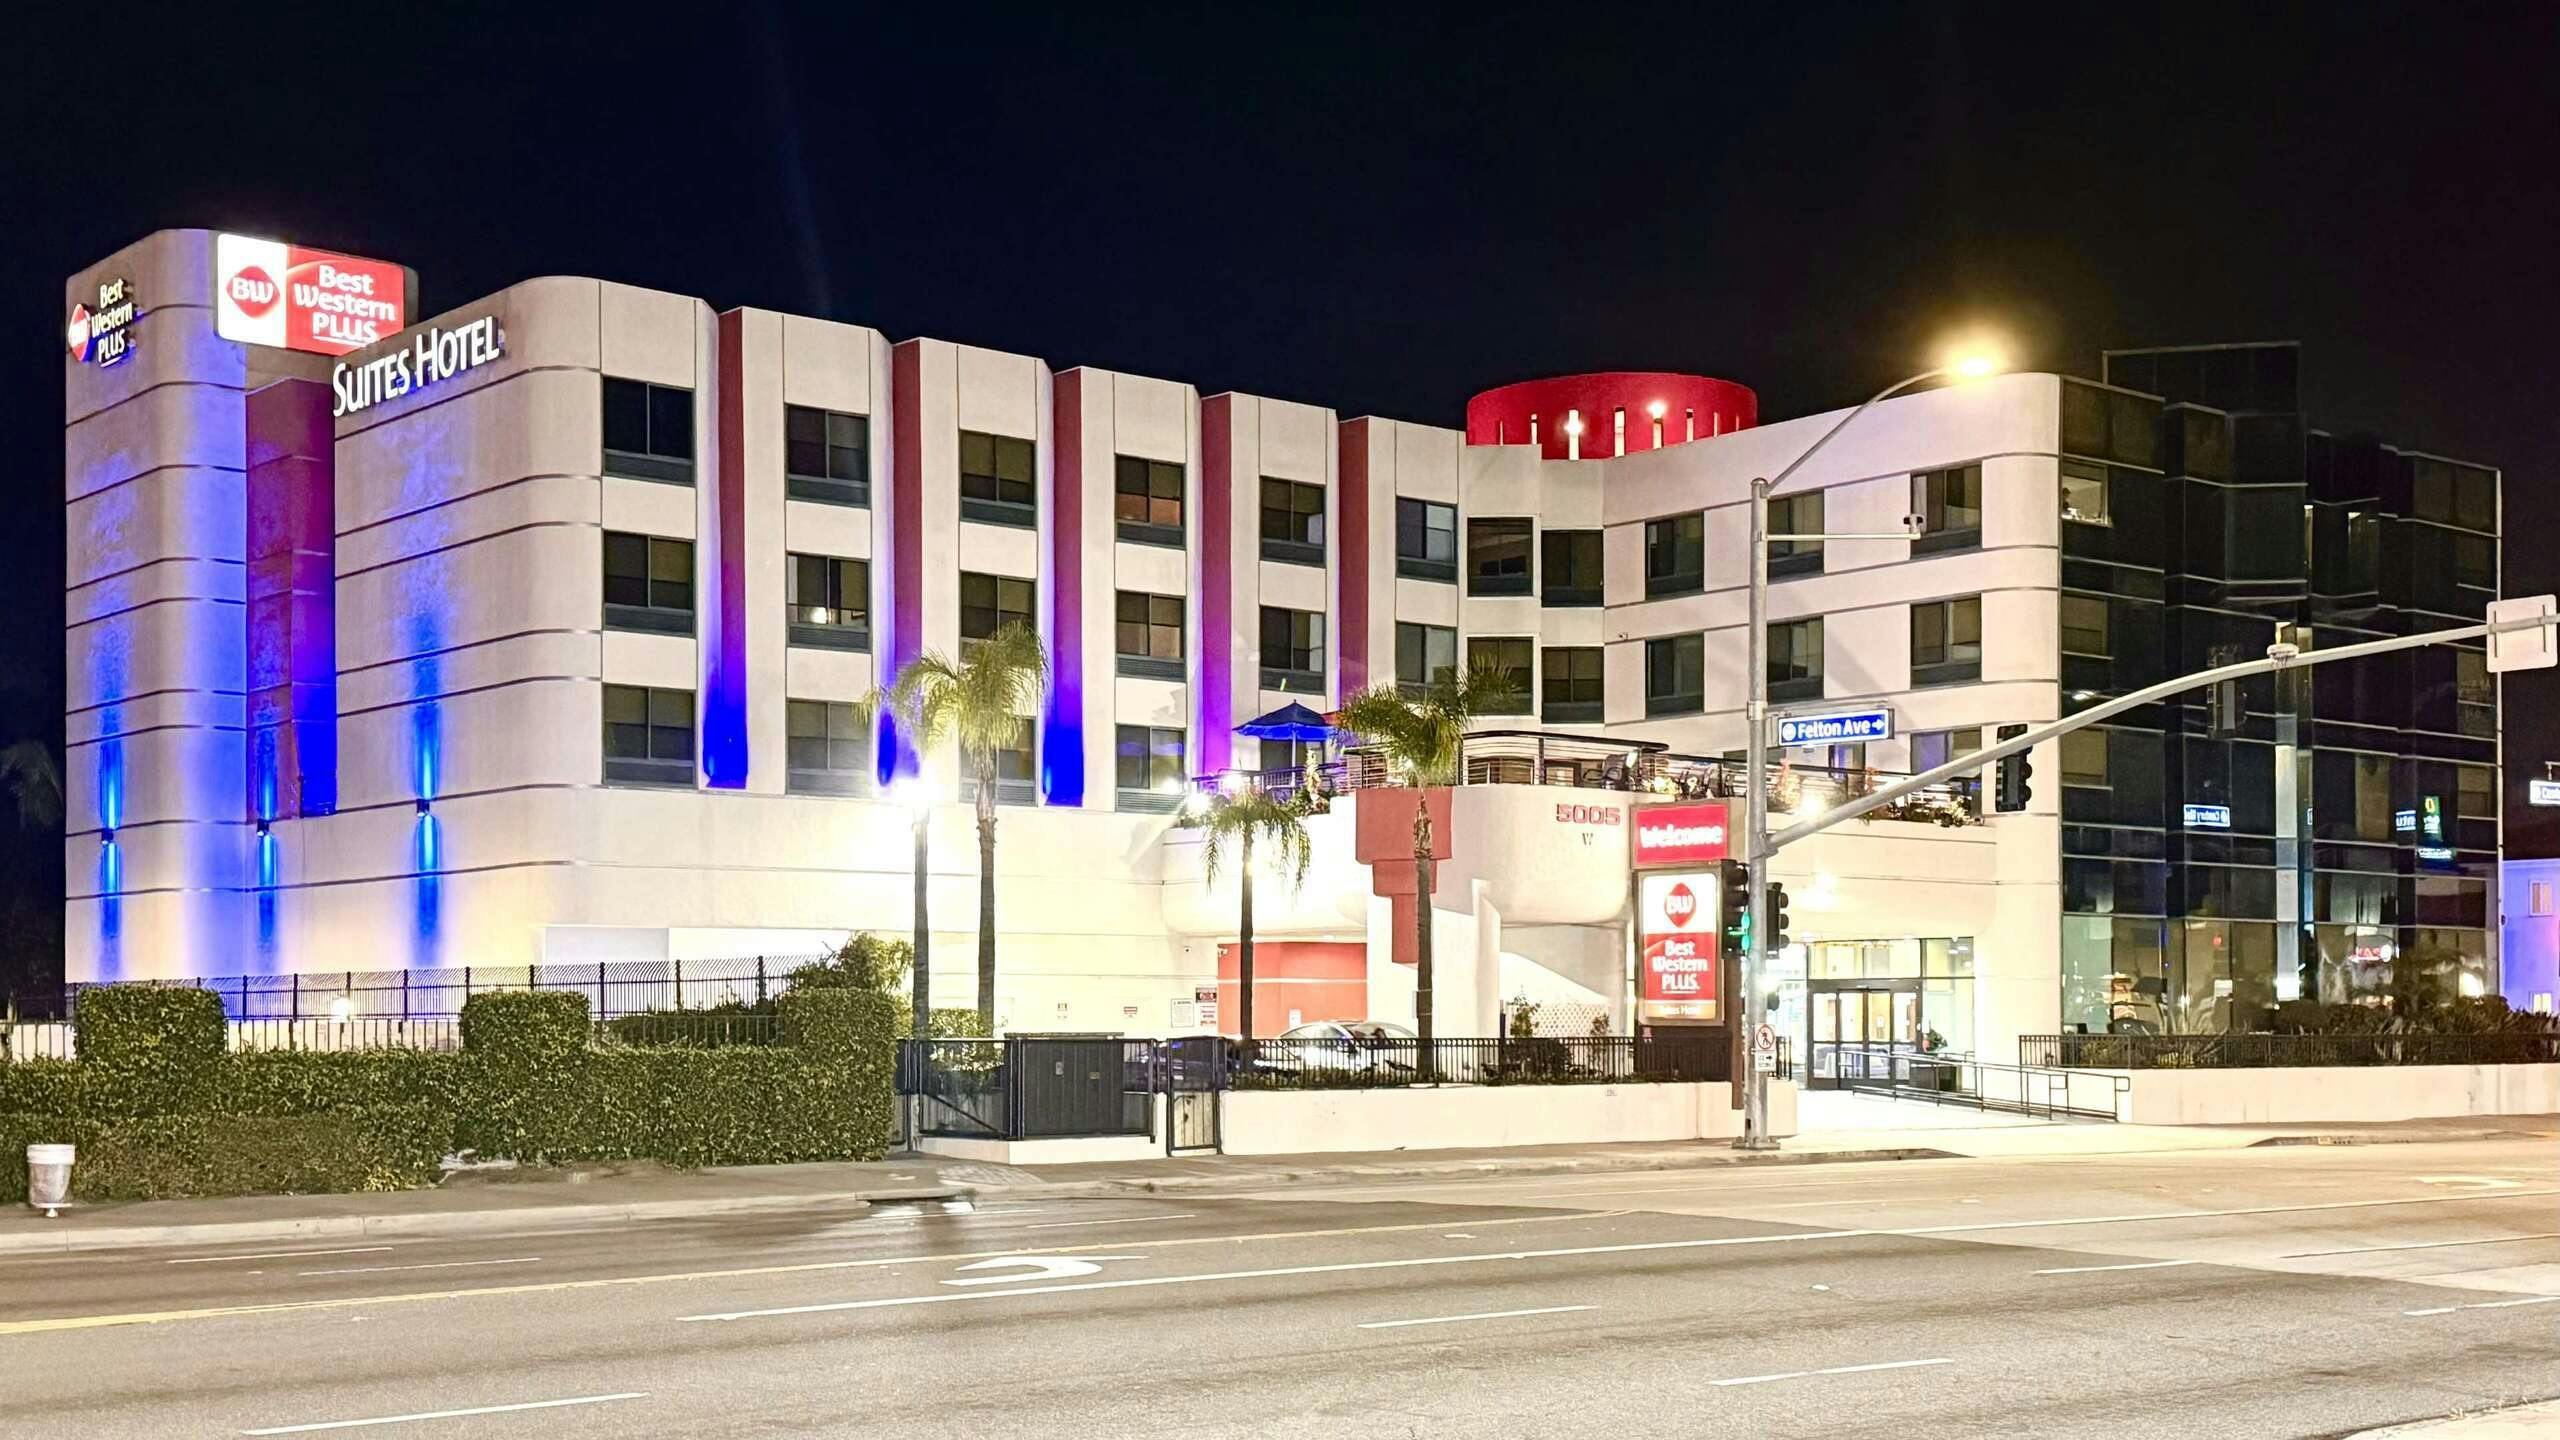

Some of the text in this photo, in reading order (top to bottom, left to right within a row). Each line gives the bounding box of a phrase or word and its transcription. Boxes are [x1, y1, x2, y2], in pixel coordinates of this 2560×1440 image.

[100, 278, 124, 309] Best
[231, 276, 274, 304] BW
[318, 264, 374, 296] Best
[293, 282, 396, 321] Western
[91, 302, 133, 339] Western
[312, 312, 381, 344] PLUS
[98, 328, 126, 363] PLUS
[416, 315, 500, 388] HOTEL
[1797, 718, 1871, 740] Felton Ave
[1556, 803, 1621, 826] 5005
[1640, 823, 1723, 848] Welcome
[1664, 939, 1695, 956] Best
[1651, 955, 1709, 972] Western
